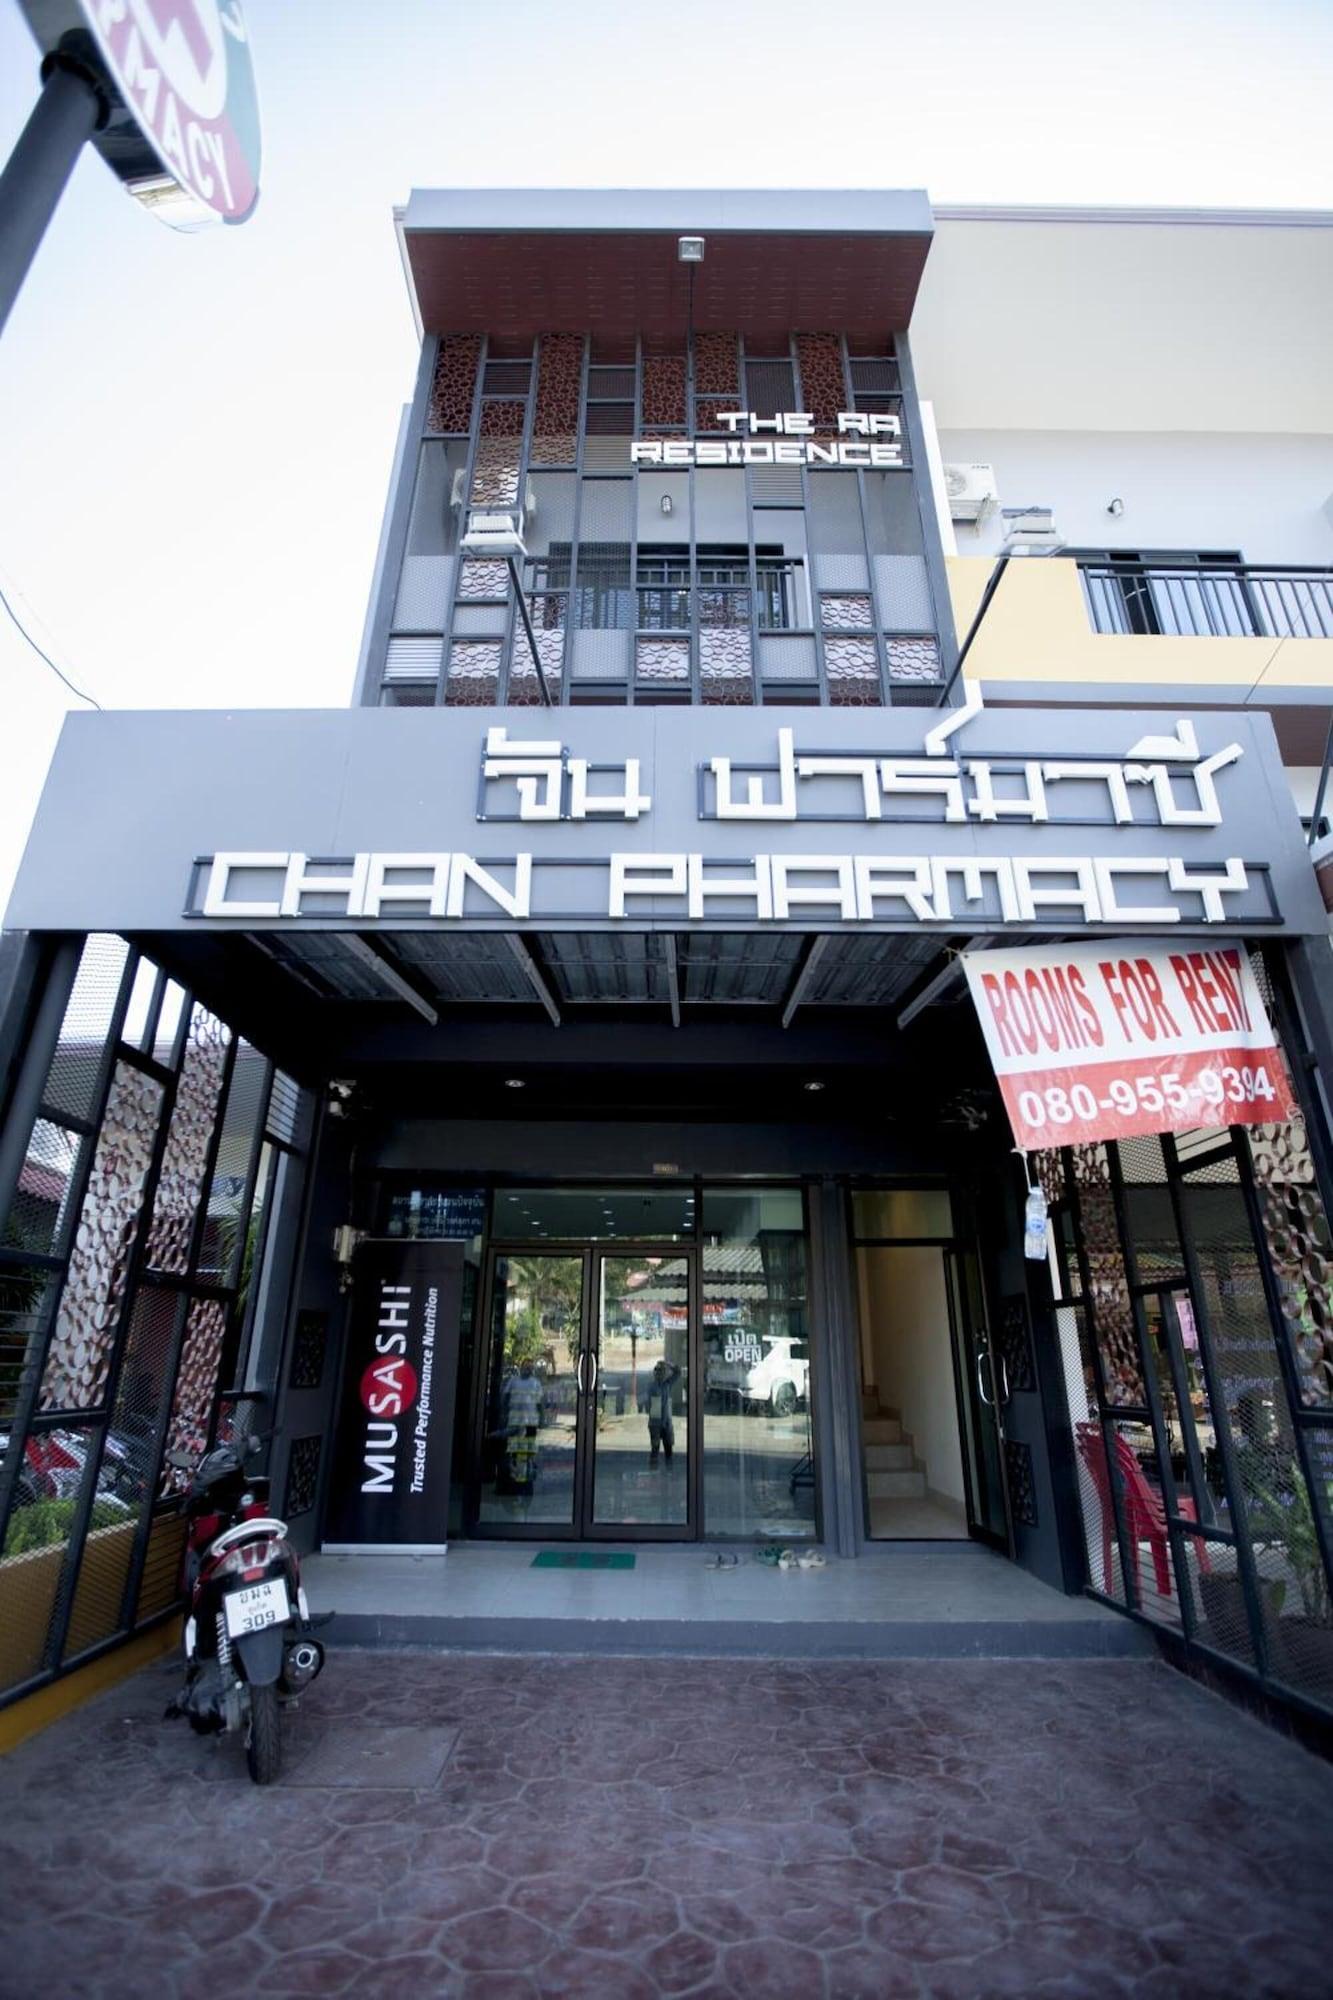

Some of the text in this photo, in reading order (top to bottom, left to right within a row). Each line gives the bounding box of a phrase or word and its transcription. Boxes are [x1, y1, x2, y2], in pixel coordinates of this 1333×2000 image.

[631, 441, 903, 465] RESIDENCE
[717, 412, 901, 435] THE RA
[203, 851, 1248, 922] CHAN PHARMACY
[981, 949, 1253, 1057] ROOMS FOR RENT
[1018, 1065, 1275, 1128] 080-955-9394
[724, 1347, 762, 1363] OPEN
[361, 1286, 411, 1493] MUSASHI
[410, 1287, 439, 1493] Trusted Performance Nutrition
[242, 1610, 277, 1632] 309
